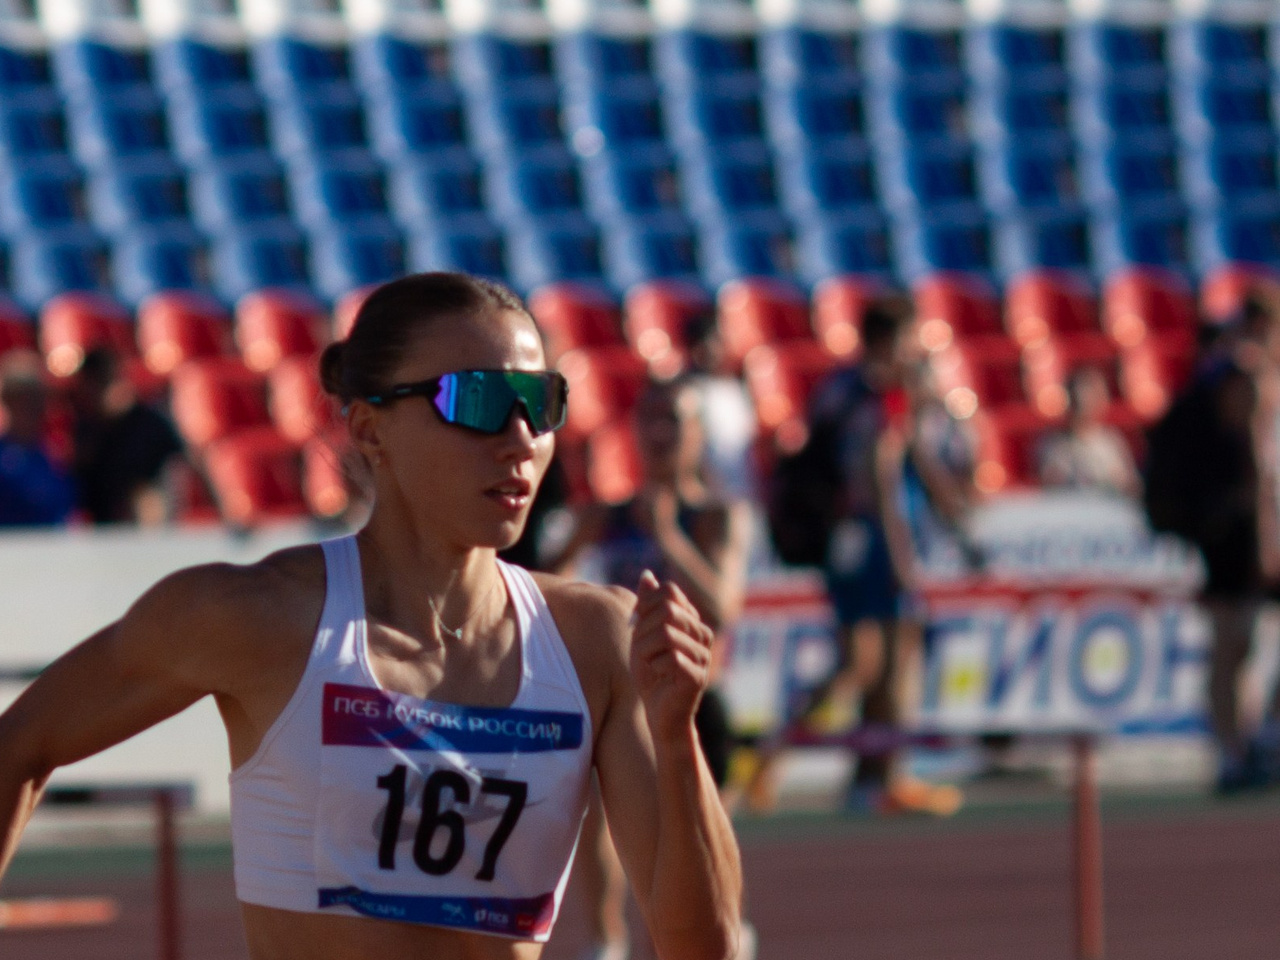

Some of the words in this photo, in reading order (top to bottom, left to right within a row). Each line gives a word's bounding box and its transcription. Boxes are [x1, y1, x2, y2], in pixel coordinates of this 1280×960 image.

[780, 608, 1212, 712] РГИОН
[333, 696, 380, 719] ПСБ
[386, 702, 463, 731] КУБОК
[468, 715, 562, 740] РОССИИ
[376, 764, 528, 882] 167
